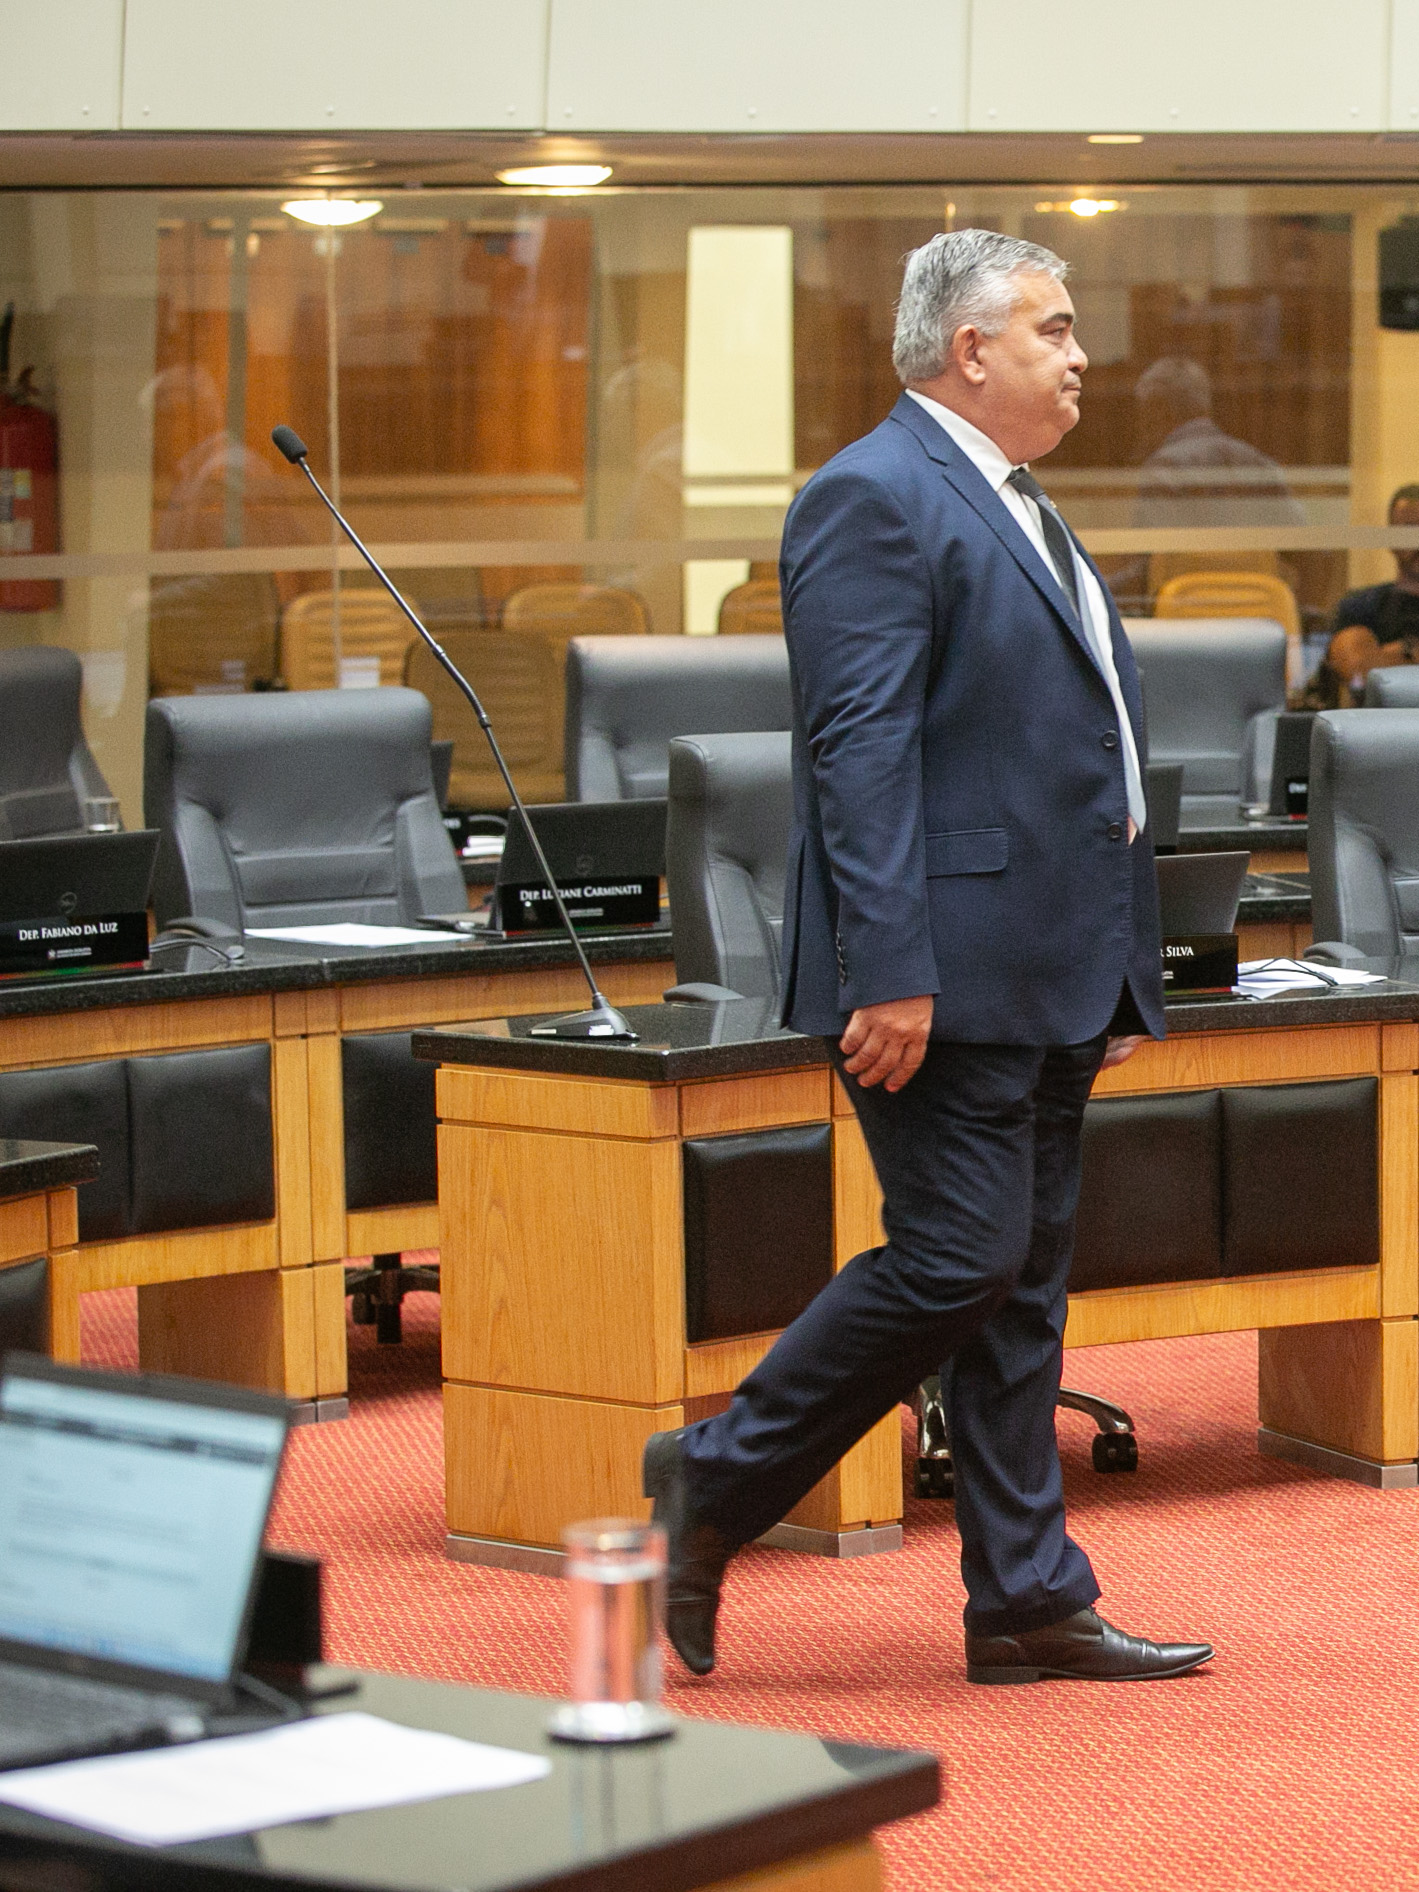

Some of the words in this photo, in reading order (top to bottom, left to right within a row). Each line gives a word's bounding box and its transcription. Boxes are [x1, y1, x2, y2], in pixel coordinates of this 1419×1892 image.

[542, 887, 582, 900] LUIANE
[583, 884, 642, 897] CARMINATTI
[19, 929, 39, 941] DEP.
[41, 925, 82, 939] FABIANO
[99, 922, 118, 933] LUZ
[1166, 945, 1194, 958] SILVA
